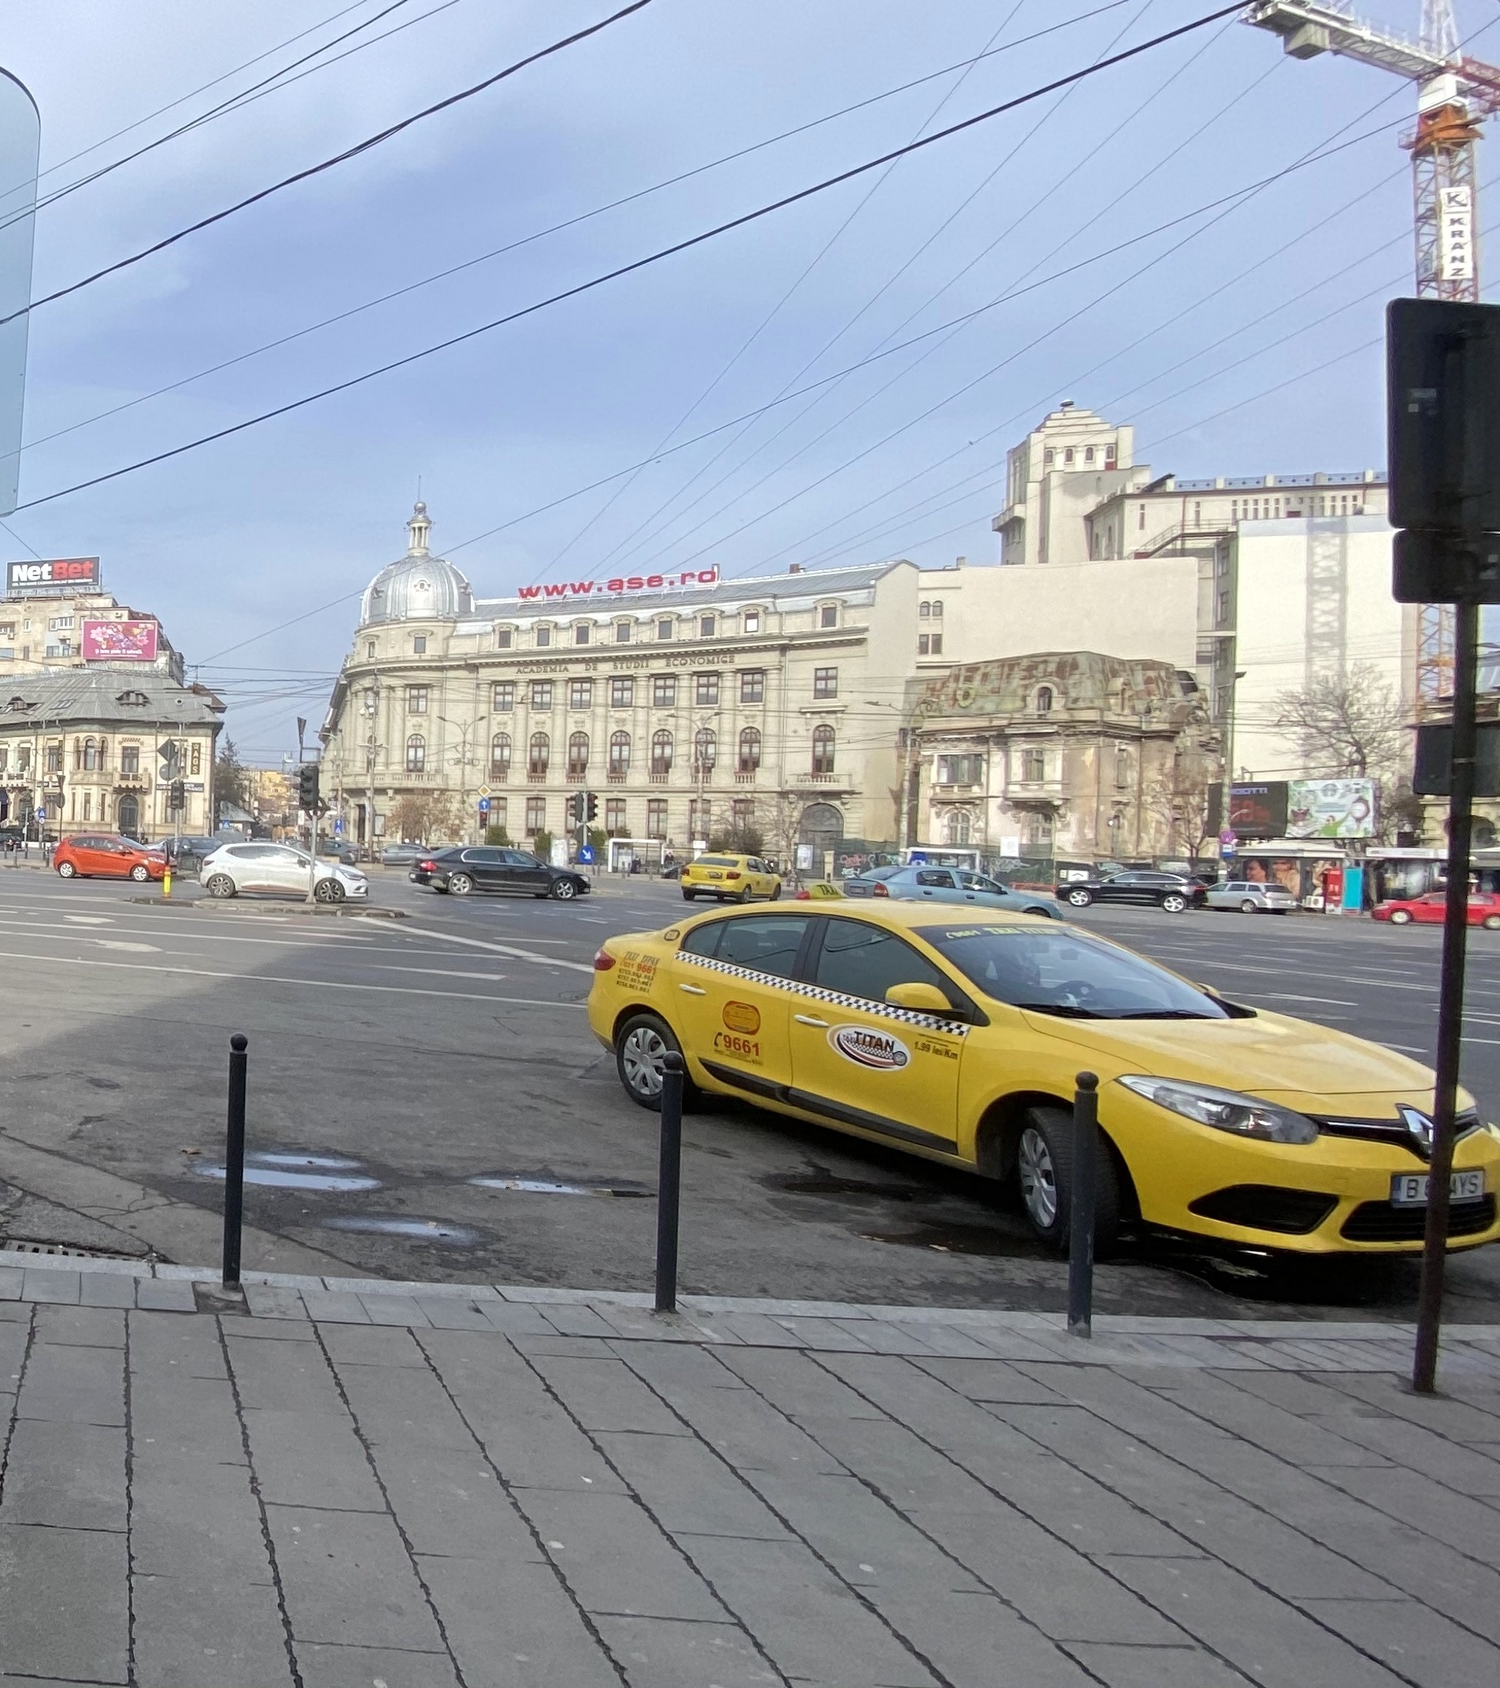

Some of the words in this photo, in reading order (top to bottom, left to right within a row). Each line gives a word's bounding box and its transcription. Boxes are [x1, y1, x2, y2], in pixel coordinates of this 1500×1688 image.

[1448, 217, 1467, 277] KRANZ
[12, 561, 94, 582] NetBet
[518, 570, 716, 598] www.ase.ro
[516, 665, 569, 674] ACADEMIA
[585, 663, 598, 671] DE
[613, 660, 650, 670] STUDII
[665, 655, 735, 667] ECONOMICE
[723, 1034, 760, 1057] 9661
[854, 1030, 895, 1052] TITAN
[1406, 1178, 1419, 1199] B
